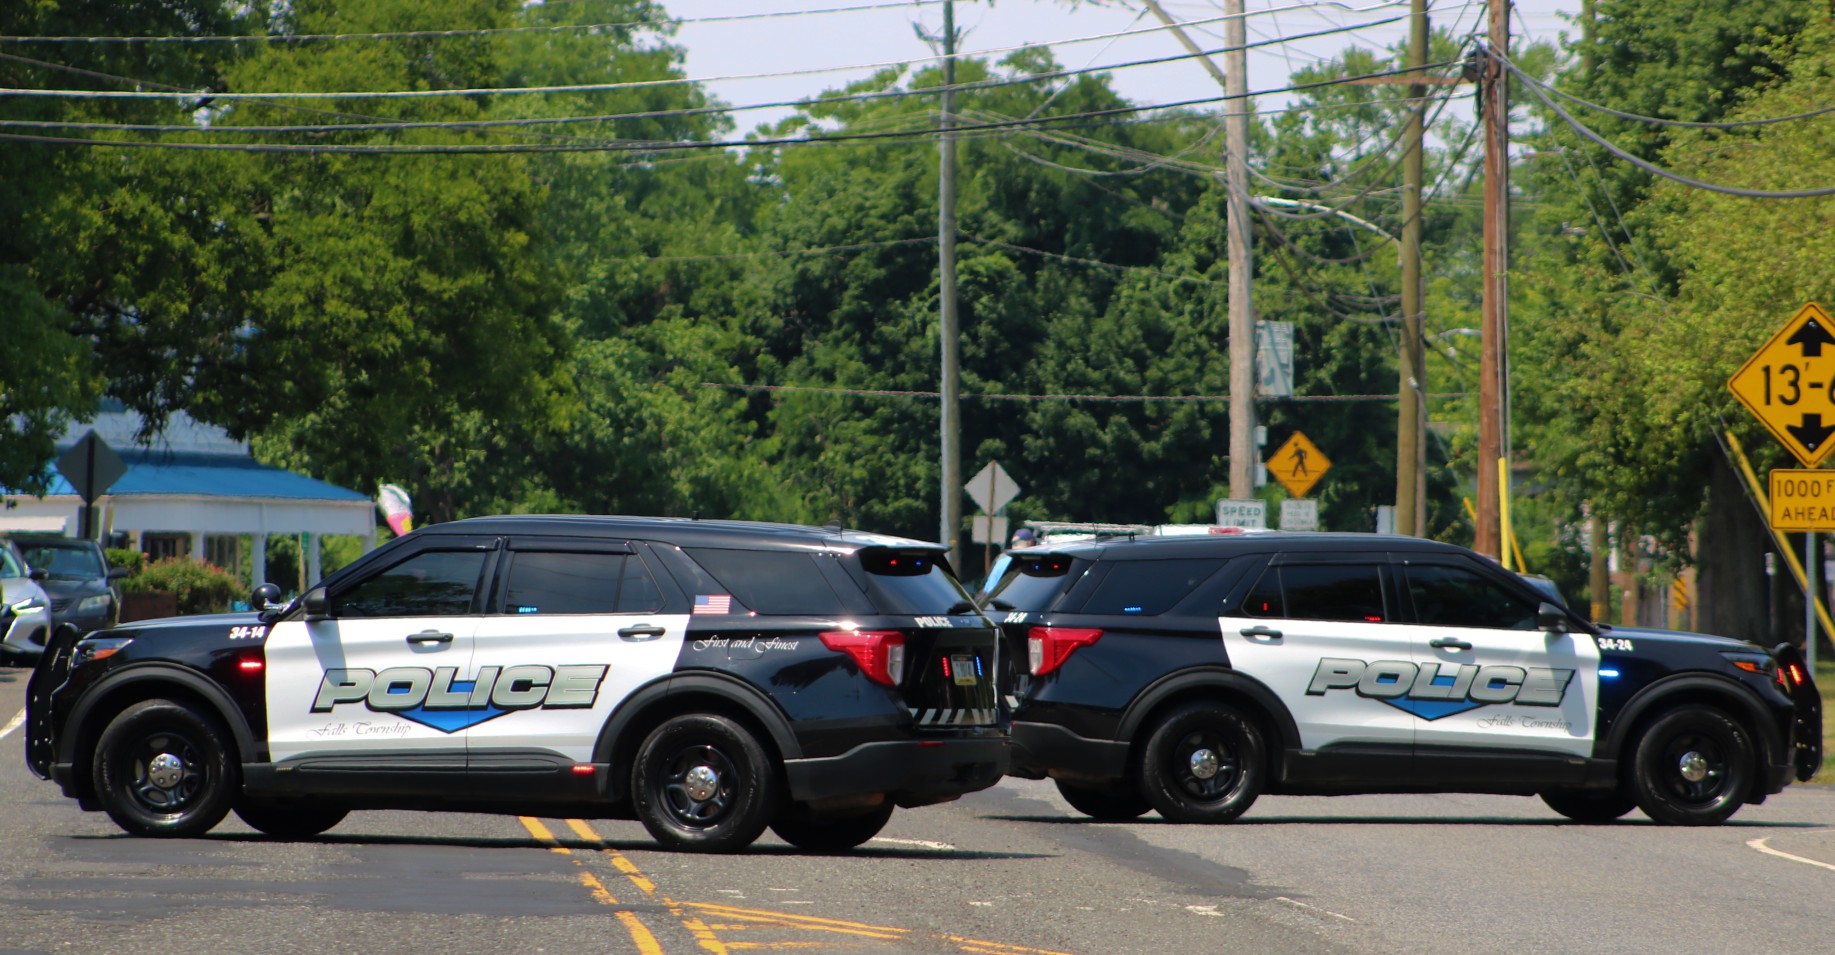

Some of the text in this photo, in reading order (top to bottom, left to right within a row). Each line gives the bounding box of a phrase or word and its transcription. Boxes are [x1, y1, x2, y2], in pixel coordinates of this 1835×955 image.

[1776, 479, 1821, 497] 1000
[1222, 506, 1261, 517] SPEED
[1224, 519, 1257, 527] LIMIT
[914, 616, 955, 628] POLICE
[229, 626, 266, 640] 34-14
[692, 635, 800, 653] First and Finest
[1597, 637, 1634, 652] 34-24
[309, 664, 612, 713] POLICE
[1305, 657, 1576, 707] POLICE
[306, 721, 412, 740] Falls Township
[1476, 713, 1573, 733] Falls Township
